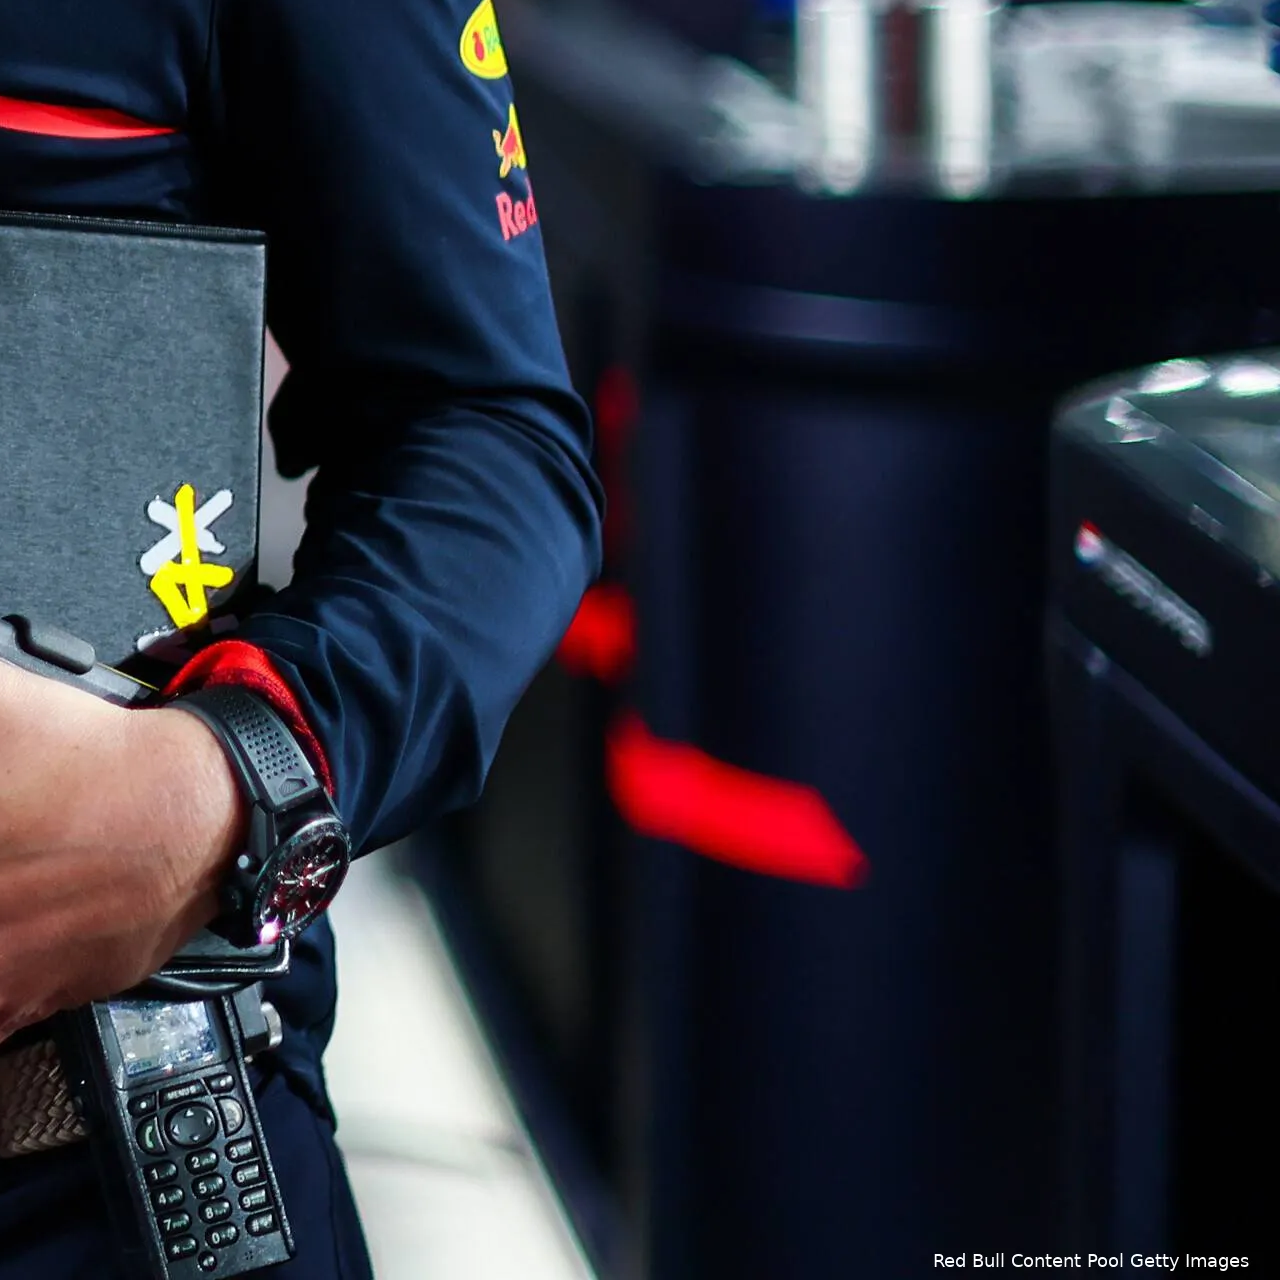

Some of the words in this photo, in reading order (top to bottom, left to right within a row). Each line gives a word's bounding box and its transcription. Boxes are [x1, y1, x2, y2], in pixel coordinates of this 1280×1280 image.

[229, 1146, 238, 1158] 3
[191, 1156, 200, 1168] 2
[151, 1168, 159, 1180] 1
[236, 1171, 245, 1182] 6
[198, 1182, 207, 1194] 5
[158, 1193, 167, 1205] 4
[242, 1196, 251, 1208] 9
[205, 1207, 214, 1219] 8
[163, 1219, 172, 1231] 7
[211, 1232, 220, 1244] 0
